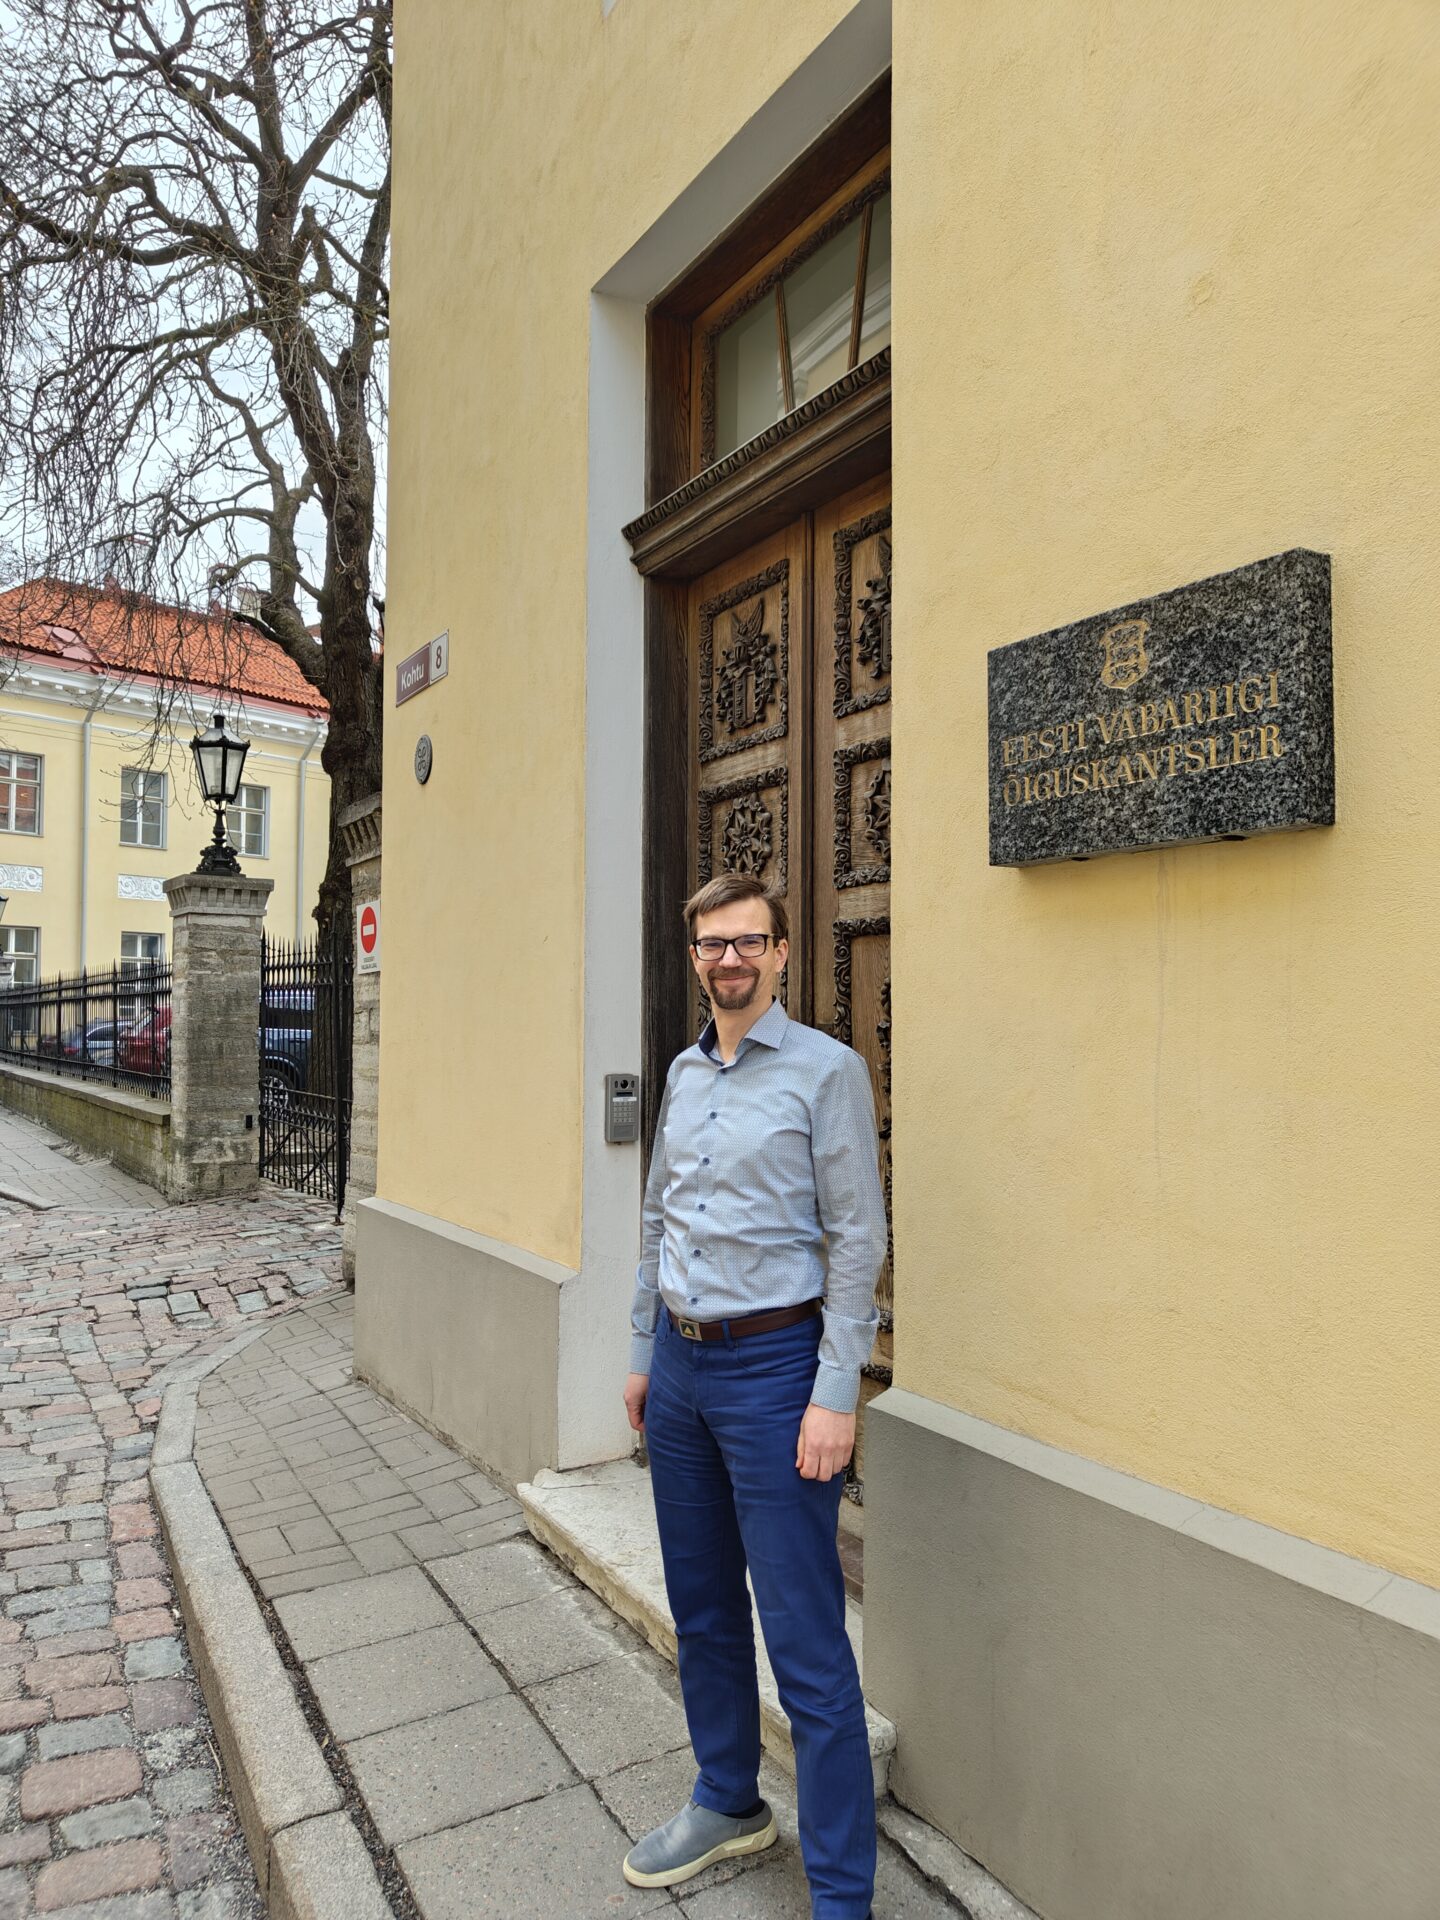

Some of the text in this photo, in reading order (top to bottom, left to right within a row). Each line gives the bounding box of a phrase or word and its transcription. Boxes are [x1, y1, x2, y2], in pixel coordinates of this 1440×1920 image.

[401, 645, 442, 692] Kohtu 8
[1003, 671, 1281, 767] EESTI VABARIIGI
[1003, 723, 1284, 807] ÕIGUSKANTSLER
